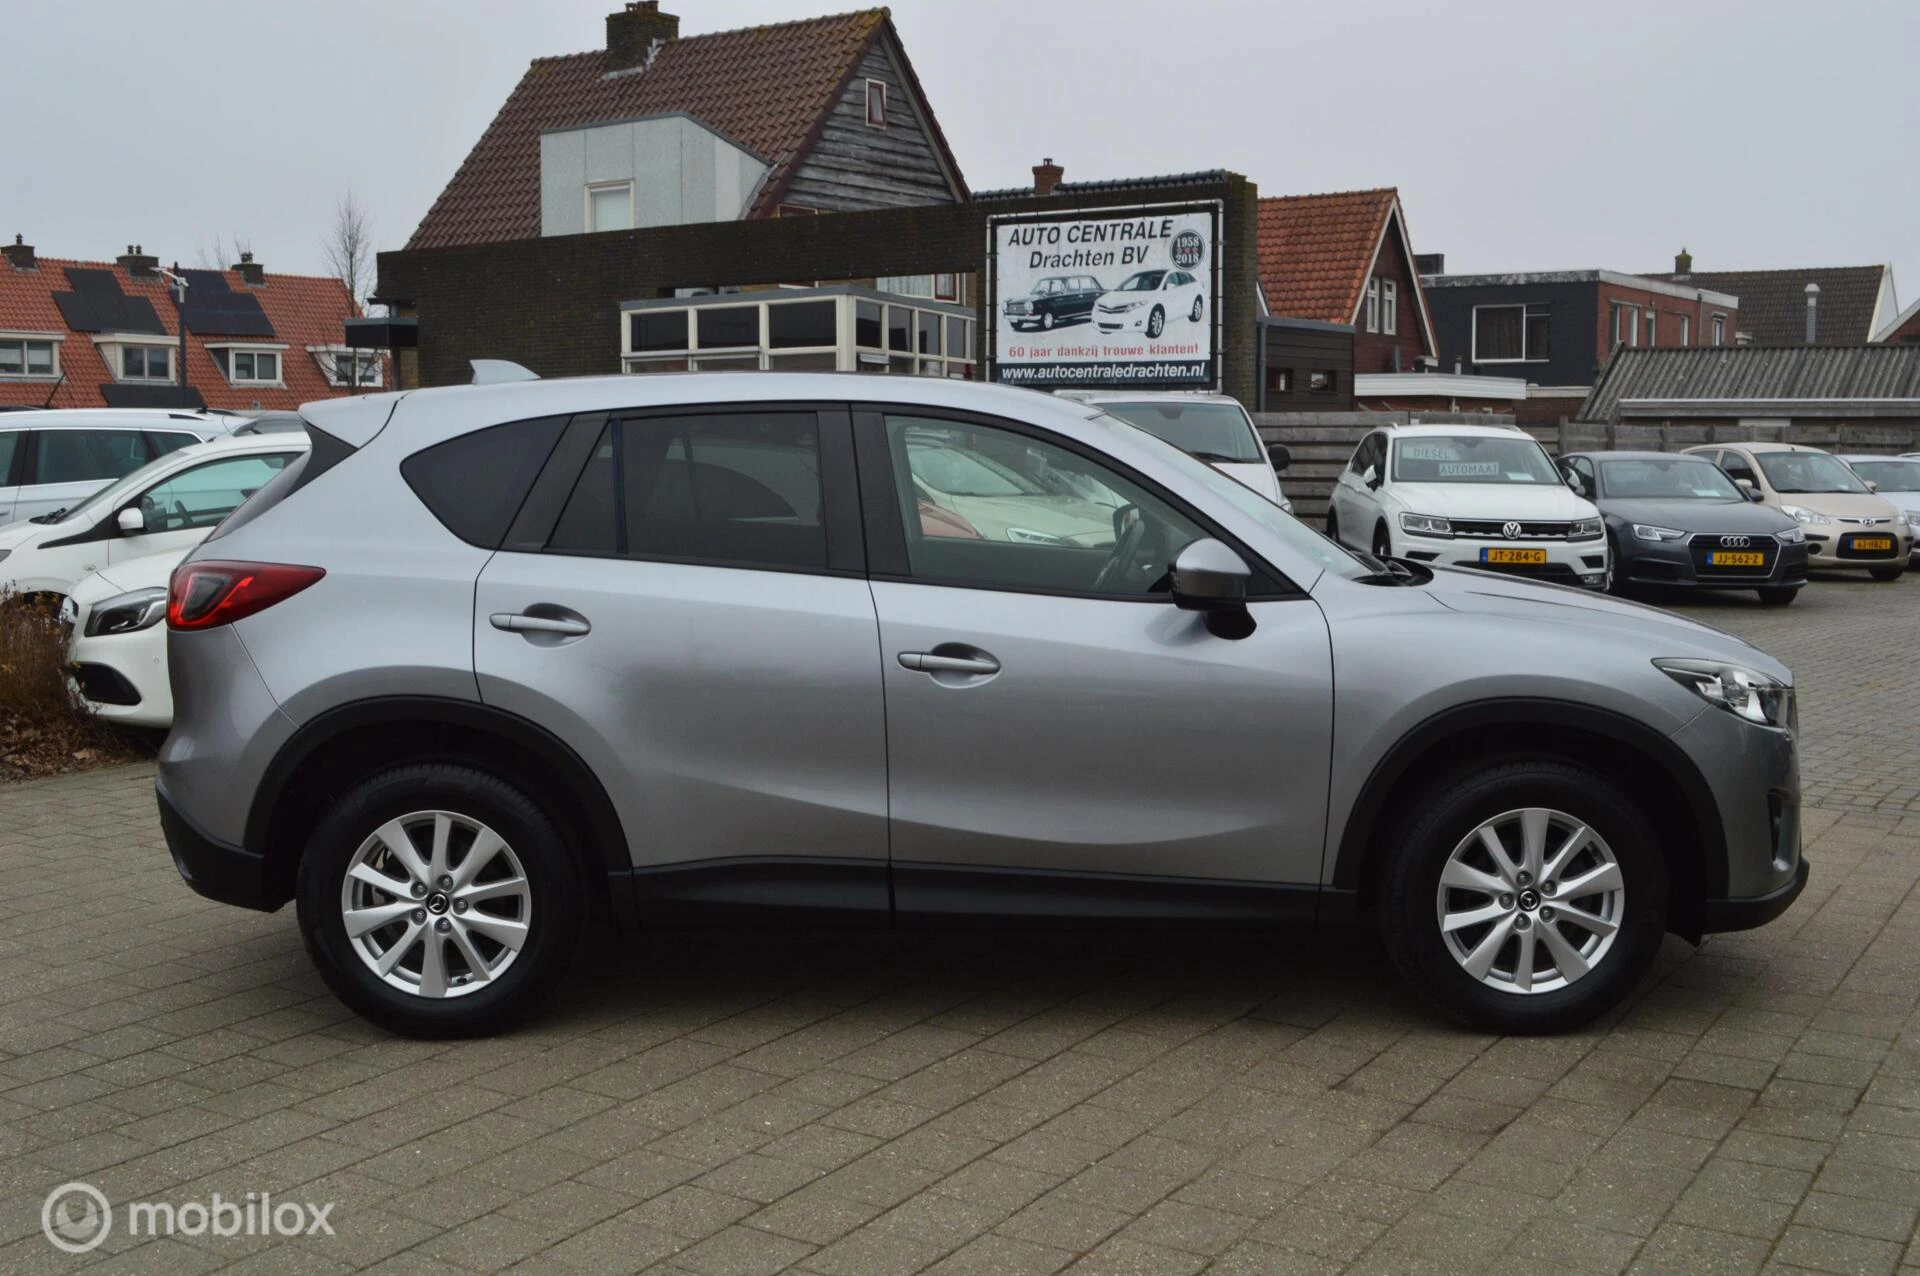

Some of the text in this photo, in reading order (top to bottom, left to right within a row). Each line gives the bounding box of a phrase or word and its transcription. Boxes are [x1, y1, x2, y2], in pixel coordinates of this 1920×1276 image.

[1008, 220, 1174, 246] AUTO CENTRALE
[1176, 236, 1200, 248] 1958
[1029, 246, 1149, 269] Drachten BV
[1175, 252, 1199, 265] 2018
[1009, 343, 1199, 359] 60 jaar dankzij trouwe klanten!
[1002, 362, 1206, 380] www.autocentraledrachten.nl
[1413, 447, 1449, 459] DIESEL
[1439, 463, 1498, 474] AUTOMAAT
[1492, 550, 1541, 562] JT-284-G
